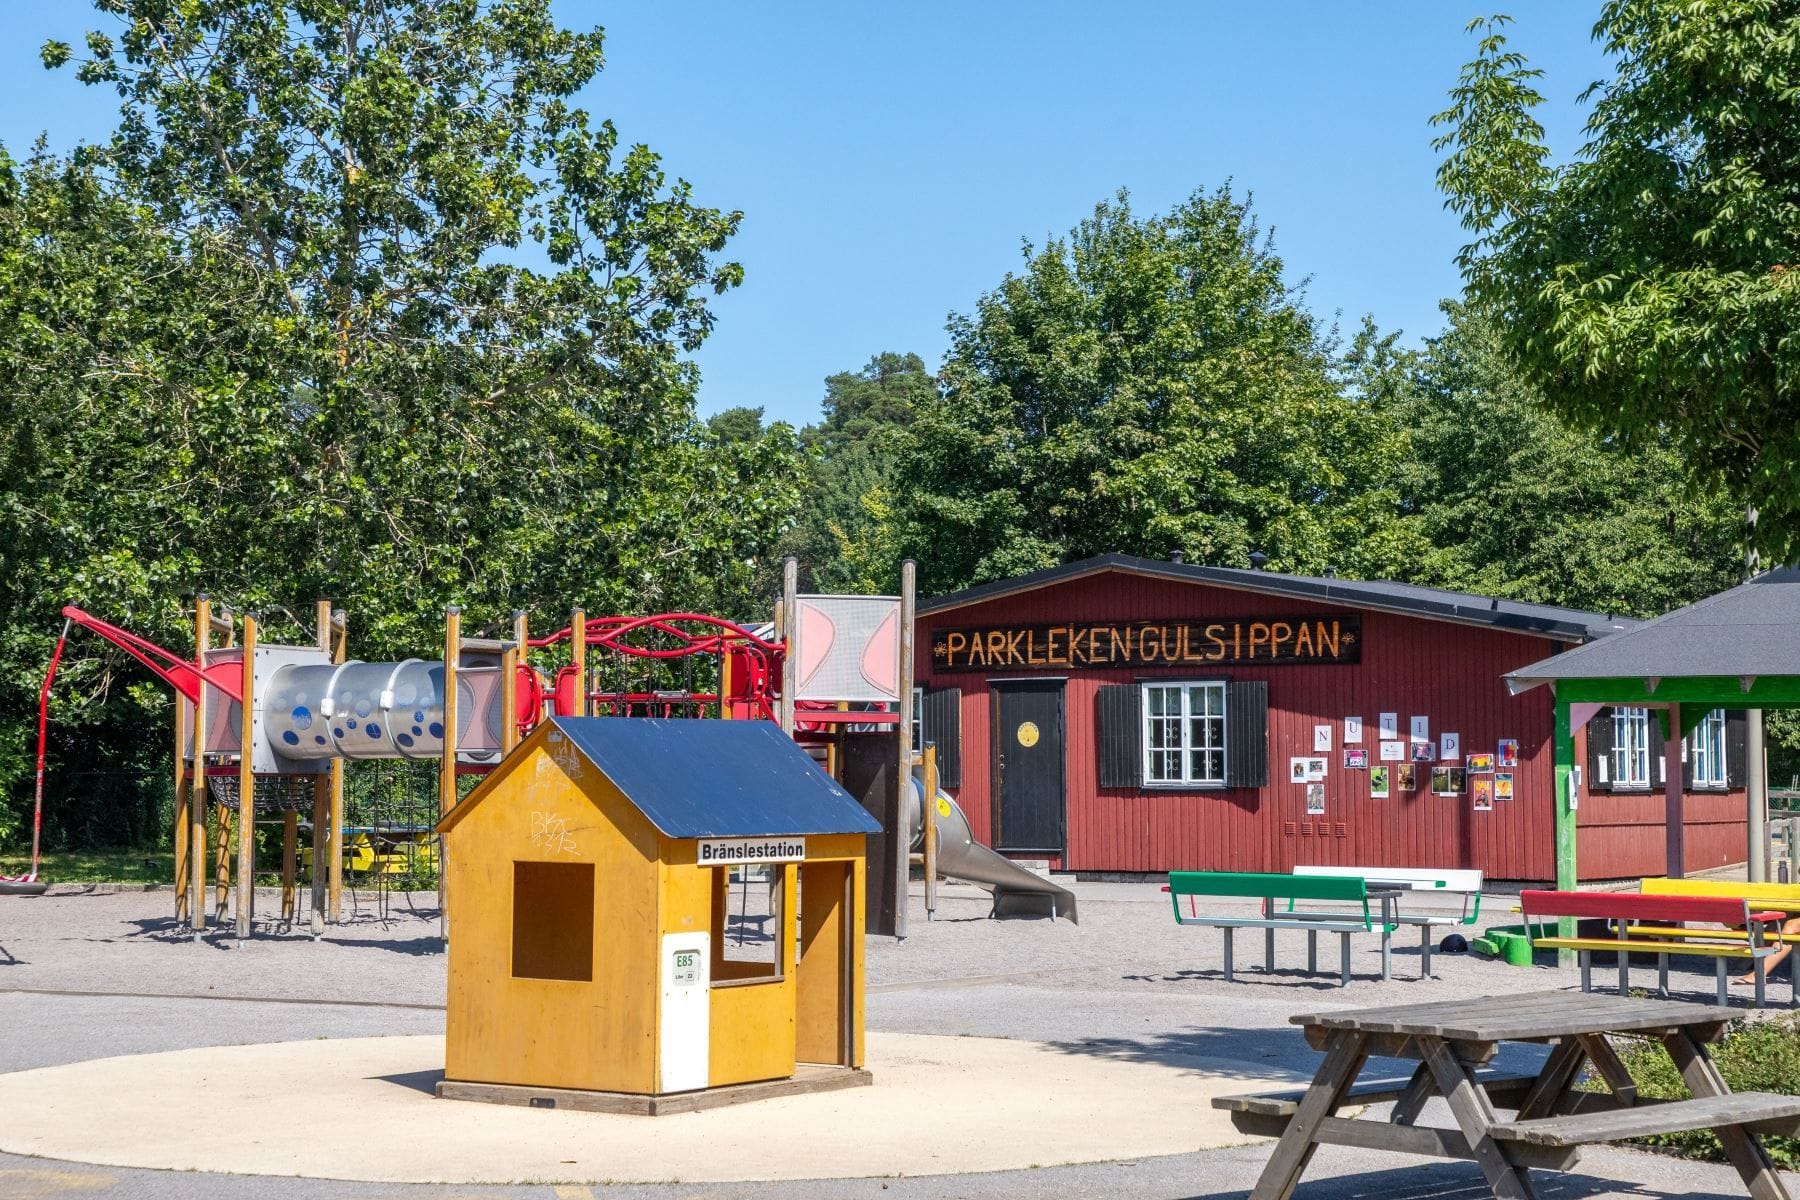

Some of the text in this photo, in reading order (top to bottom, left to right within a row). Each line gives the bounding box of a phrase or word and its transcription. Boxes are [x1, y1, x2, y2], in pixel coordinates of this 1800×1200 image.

[947, 620, 1339, 667] PARKLEKEN GULSIPPAN
[702, 841, 803, 860] Bränslestation
[677, 955, 693, 967] E85
